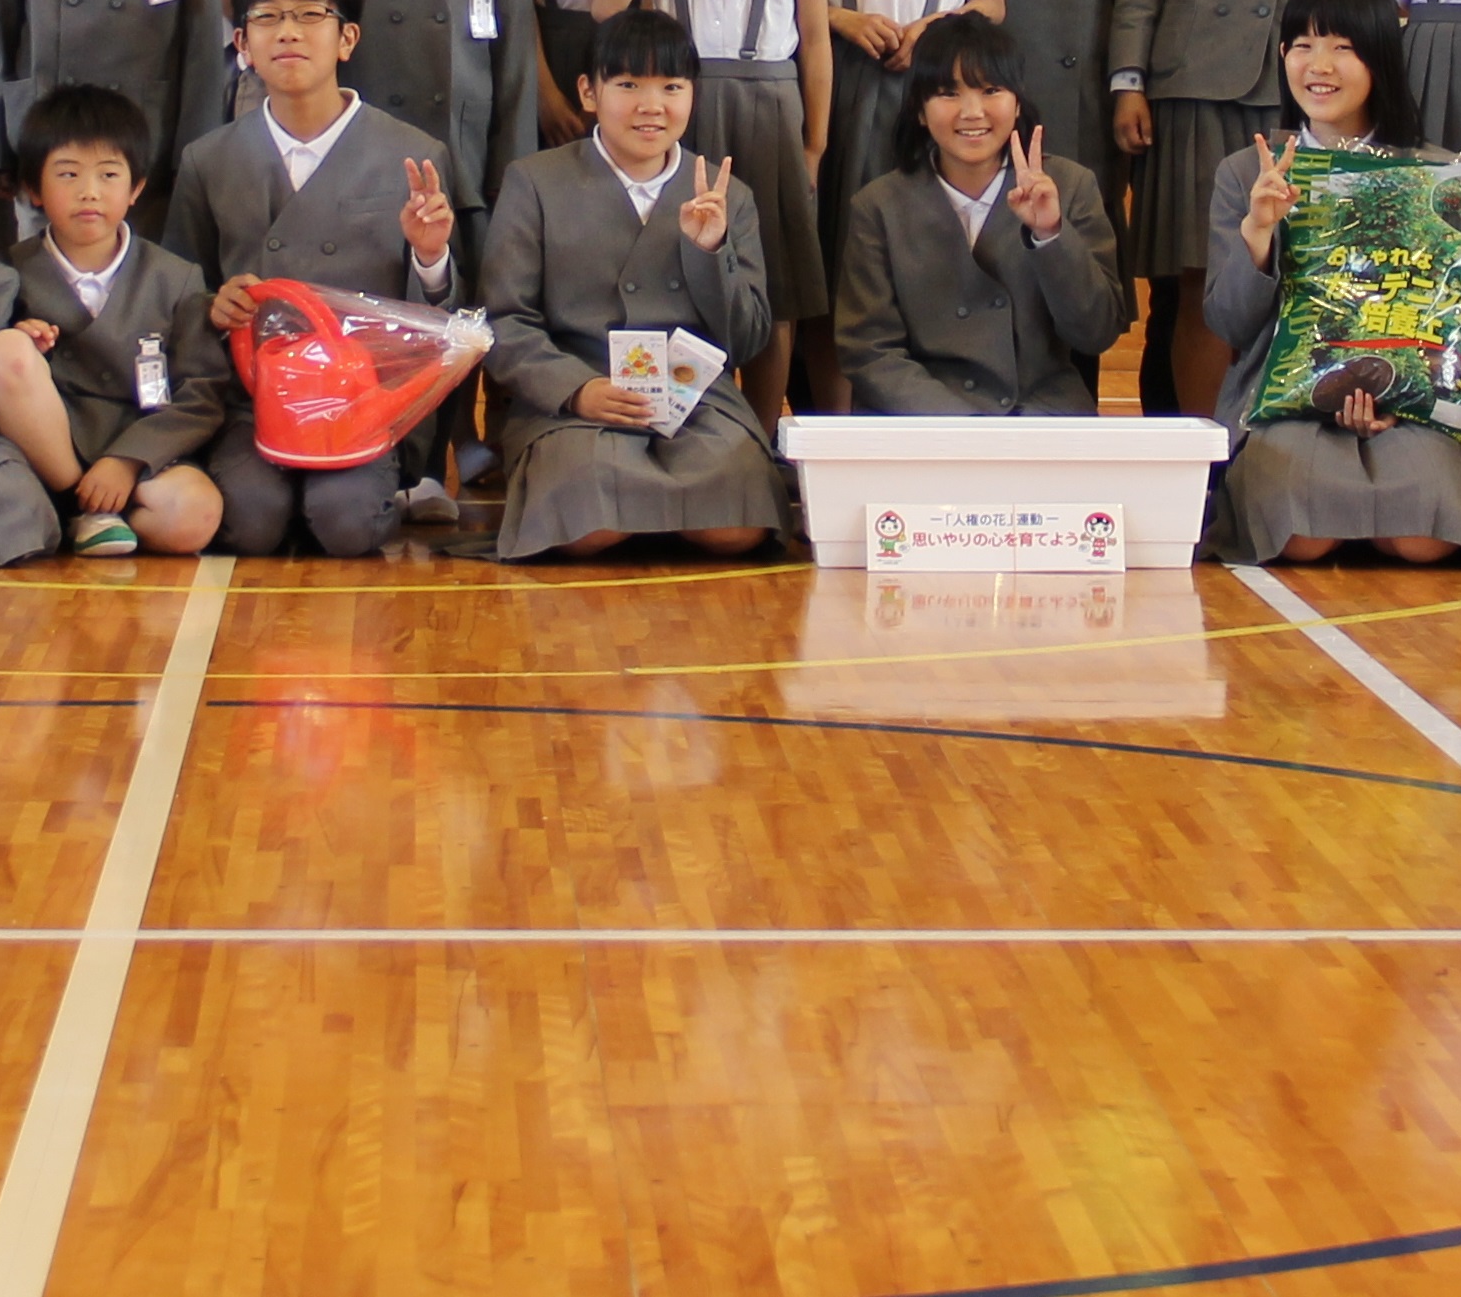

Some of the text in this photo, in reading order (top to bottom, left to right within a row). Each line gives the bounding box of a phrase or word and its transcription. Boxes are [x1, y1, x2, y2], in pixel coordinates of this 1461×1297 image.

[1359, 301, 1445, 345] 培養土
[912, 532, 1079, 548] 思いやりの心を育てよう
